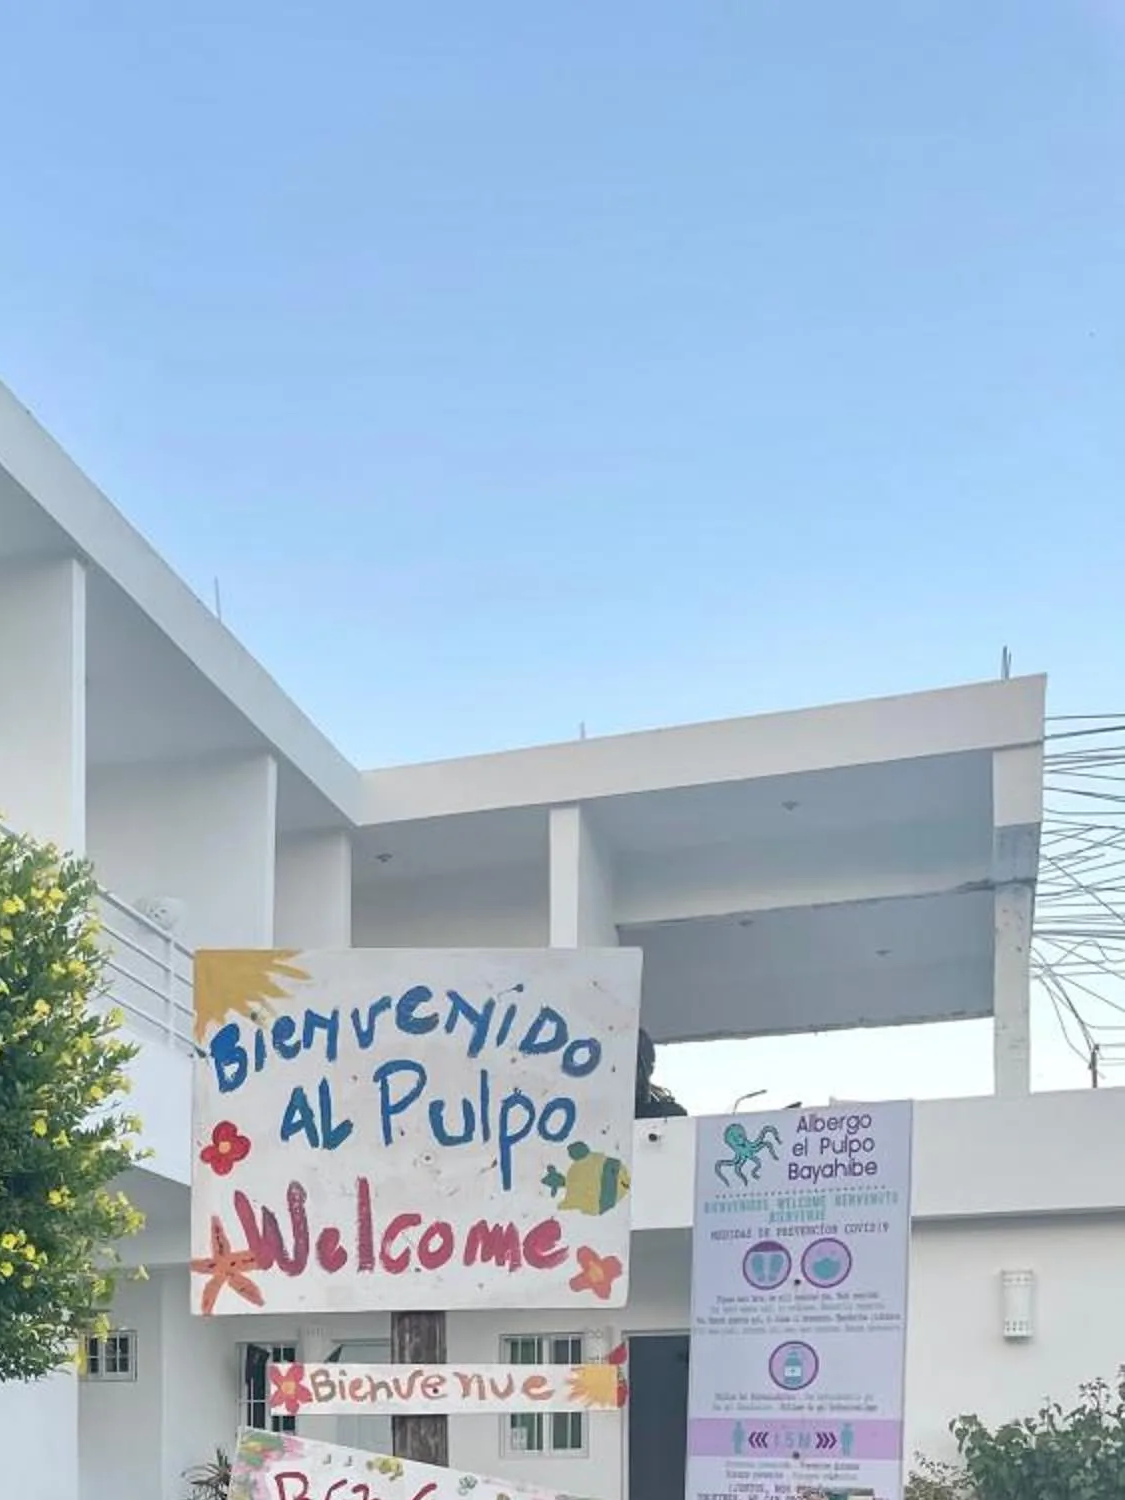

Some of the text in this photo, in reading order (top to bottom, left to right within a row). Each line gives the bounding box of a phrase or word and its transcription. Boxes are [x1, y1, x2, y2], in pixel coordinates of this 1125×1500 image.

[373, 1059, 576, 1190] Pulpo
[796, 1113, 872, 1135] Albergo
[792, 1136, 875, 1159] el Pulpo
[788, 1158, 878, 1184] Bayahibe
[234, 1176, 569, 1278] Welcome
[310, 1368, 555, 1404] Bienvenue
